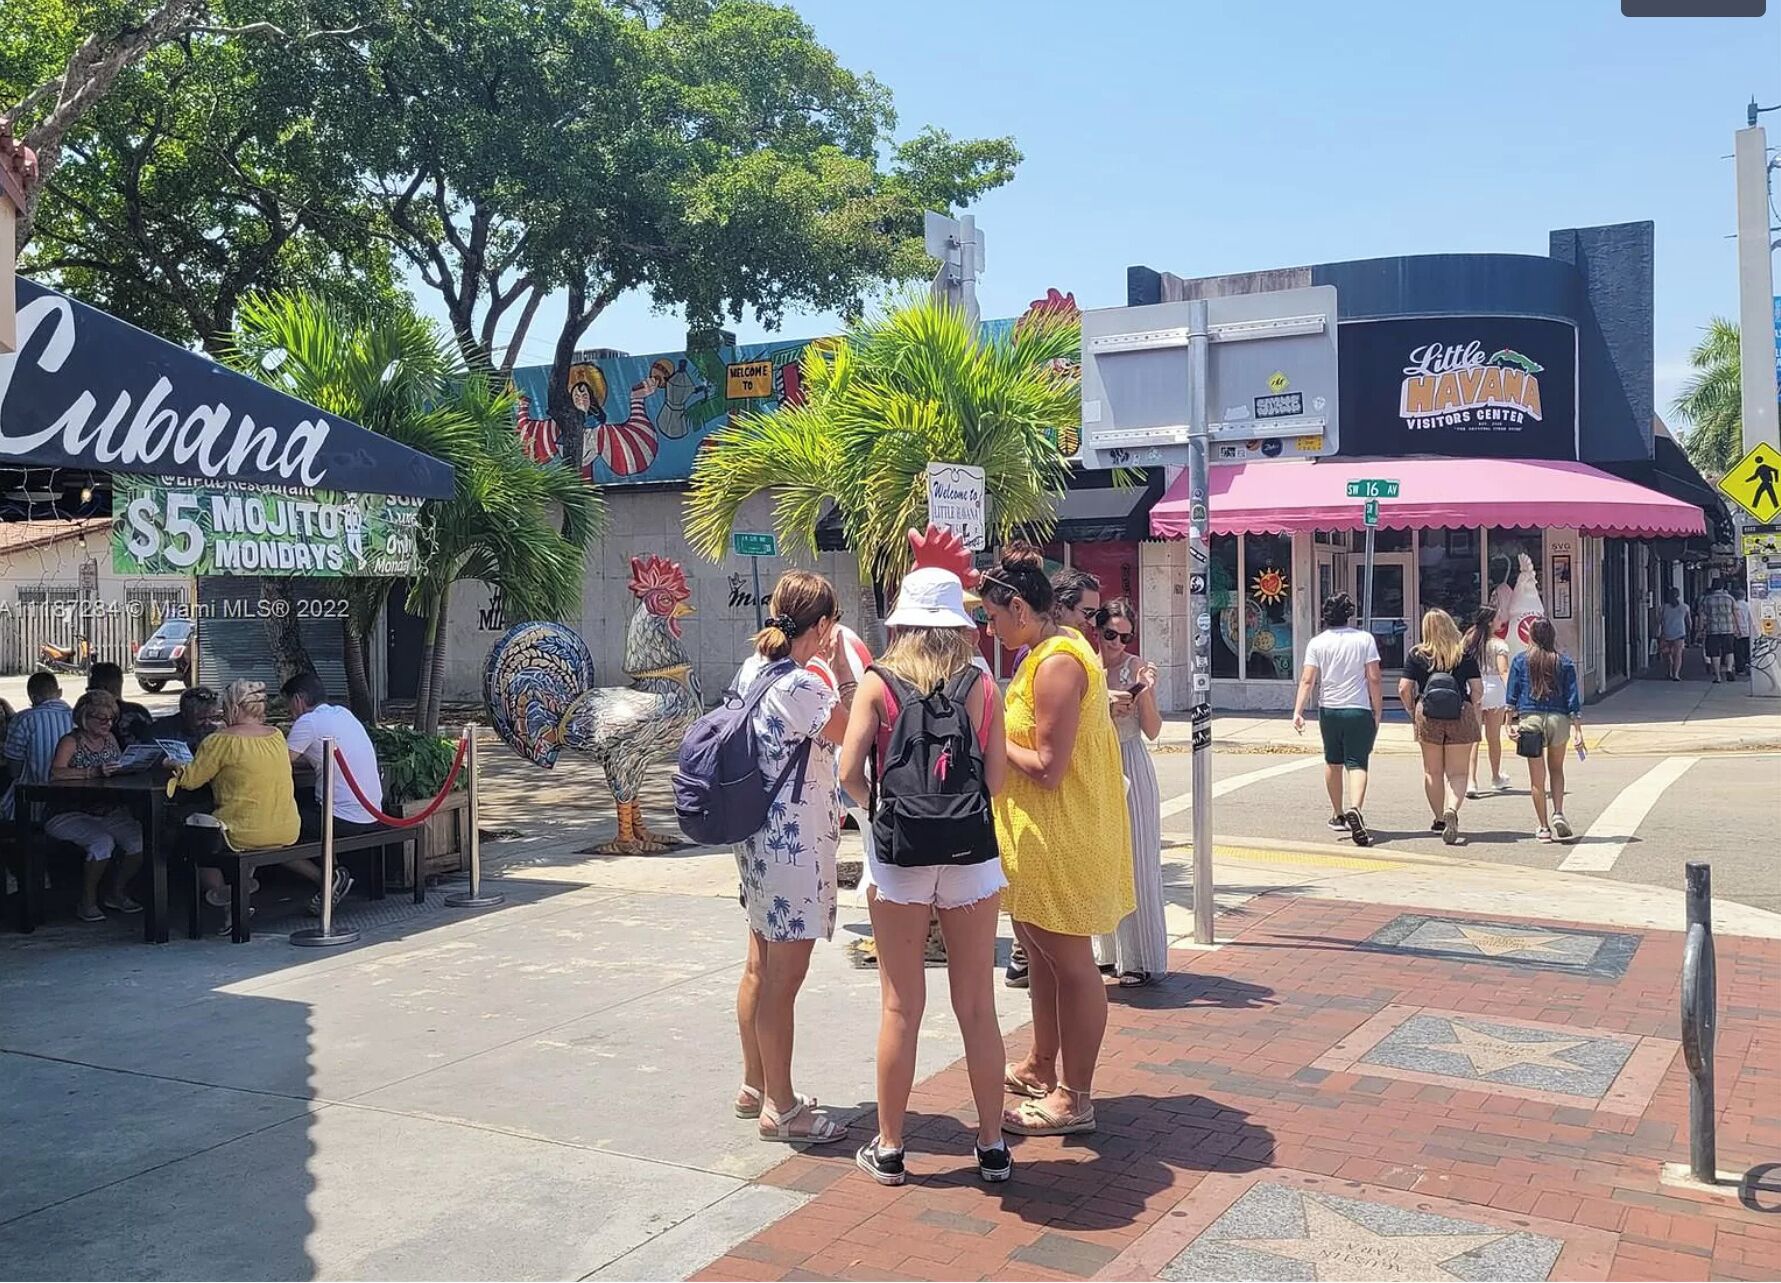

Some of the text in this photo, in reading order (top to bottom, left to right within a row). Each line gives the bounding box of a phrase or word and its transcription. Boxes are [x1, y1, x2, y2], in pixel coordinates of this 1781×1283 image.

[1403, 340, 1486, 375] Little
[729, 365, 768, 378] WELCOME
[0, 295, 330, 487] Cubana
[743, 381, 753, 390] TO
[1401, 366, 1542, 419] HAVANA
[1407, 408, 1524, 430] VISITORS CENTER
[933, 480, 978, 501] Welcome to
[1347, 481, 1398, 497] SW 16 AV
[934, 506, 955, 520] LITTLE
[127, 488, 205, 566] $5
[215, 539, 344, 571] MONDAYS
